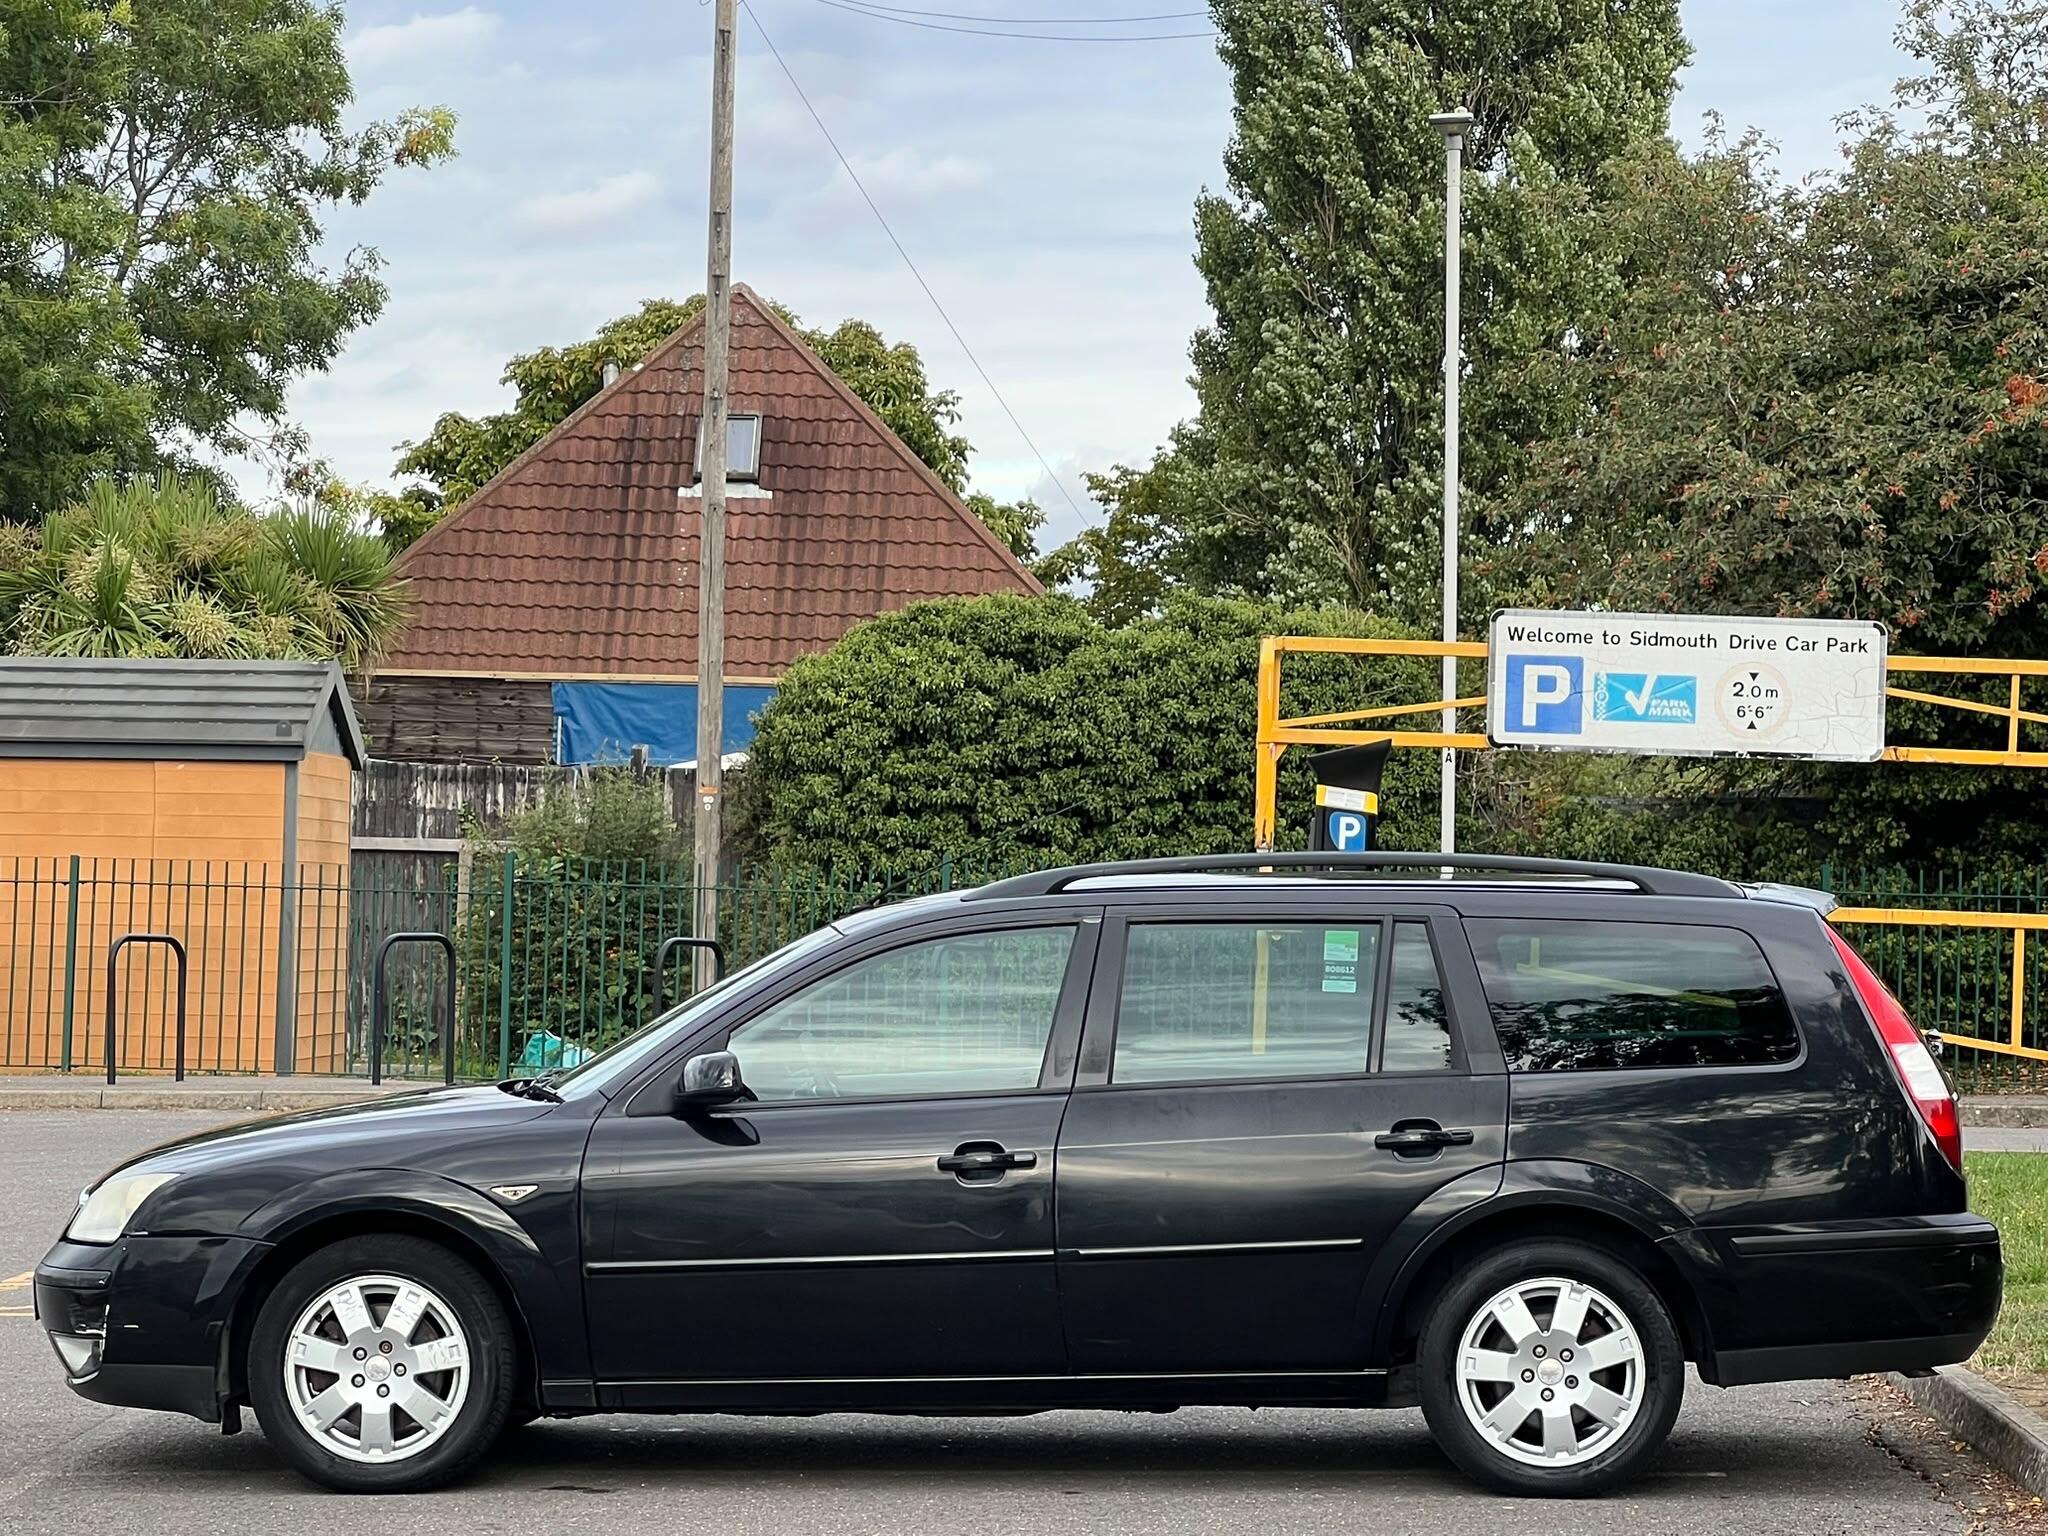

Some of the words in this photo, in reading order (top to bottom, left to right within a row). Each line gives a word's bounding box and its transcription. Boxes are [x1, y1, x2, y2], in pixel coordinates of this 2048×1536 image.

[1507, 625, 1594, 645] Welcome
[1602, 629, 1621, 646] to
[1629, 630, 1718, 649] Sidmouth
[1729, 634, 1777, 651] Drive
[1785, 635, 1819, 652] Car
[1826, 637, 1869, 654] Park
[1522, 664, 1571, 727] P
[1651, 698, 1690, 708] PARK
[1648, 707, 1693, 718] MARK
[1444, 752, 1453, 763] A
[1338, 815, 1361, 850] P
